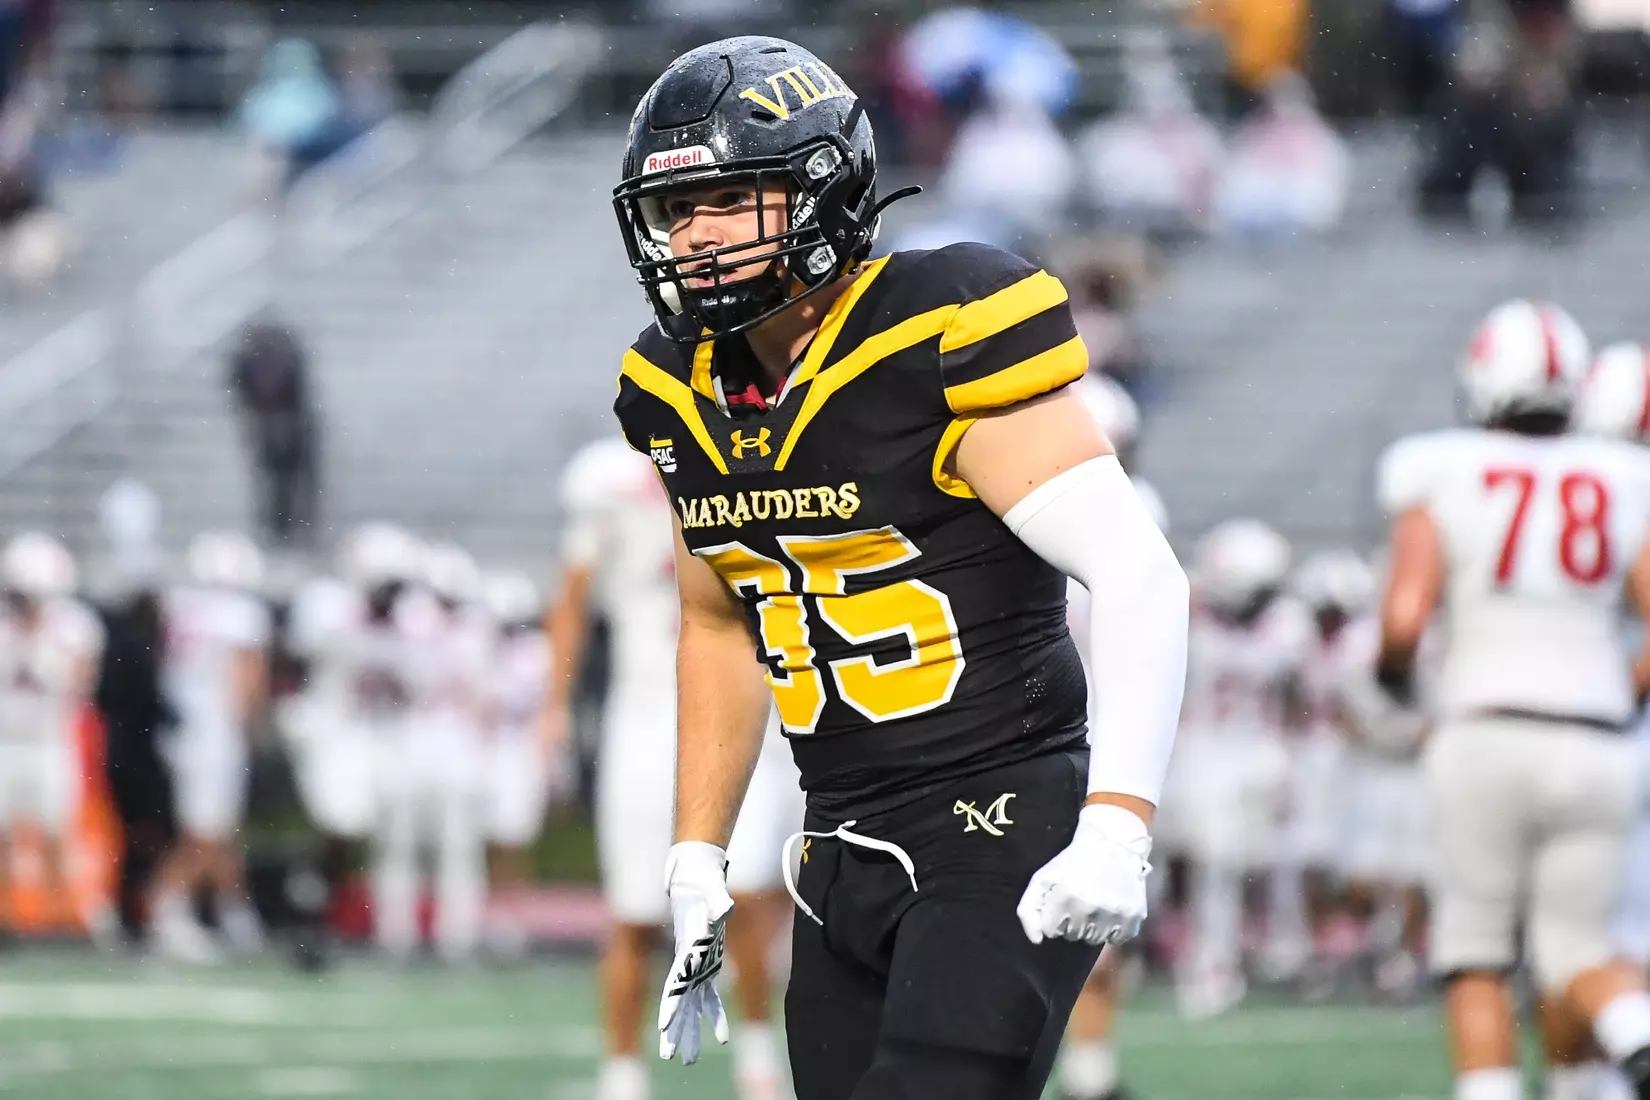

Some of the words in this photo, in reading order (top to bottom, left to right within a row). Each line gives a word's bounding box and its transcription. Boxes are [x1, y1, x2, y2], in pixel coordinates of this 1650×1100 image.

[649, 150, 702, 171] Riddell
[650, 446, 676, 465] PSAC
[678, 481, 861, 529] MARAUDERS
[1483, 467, 1612, 586] 78
[691, 524, 967, 735] 35
